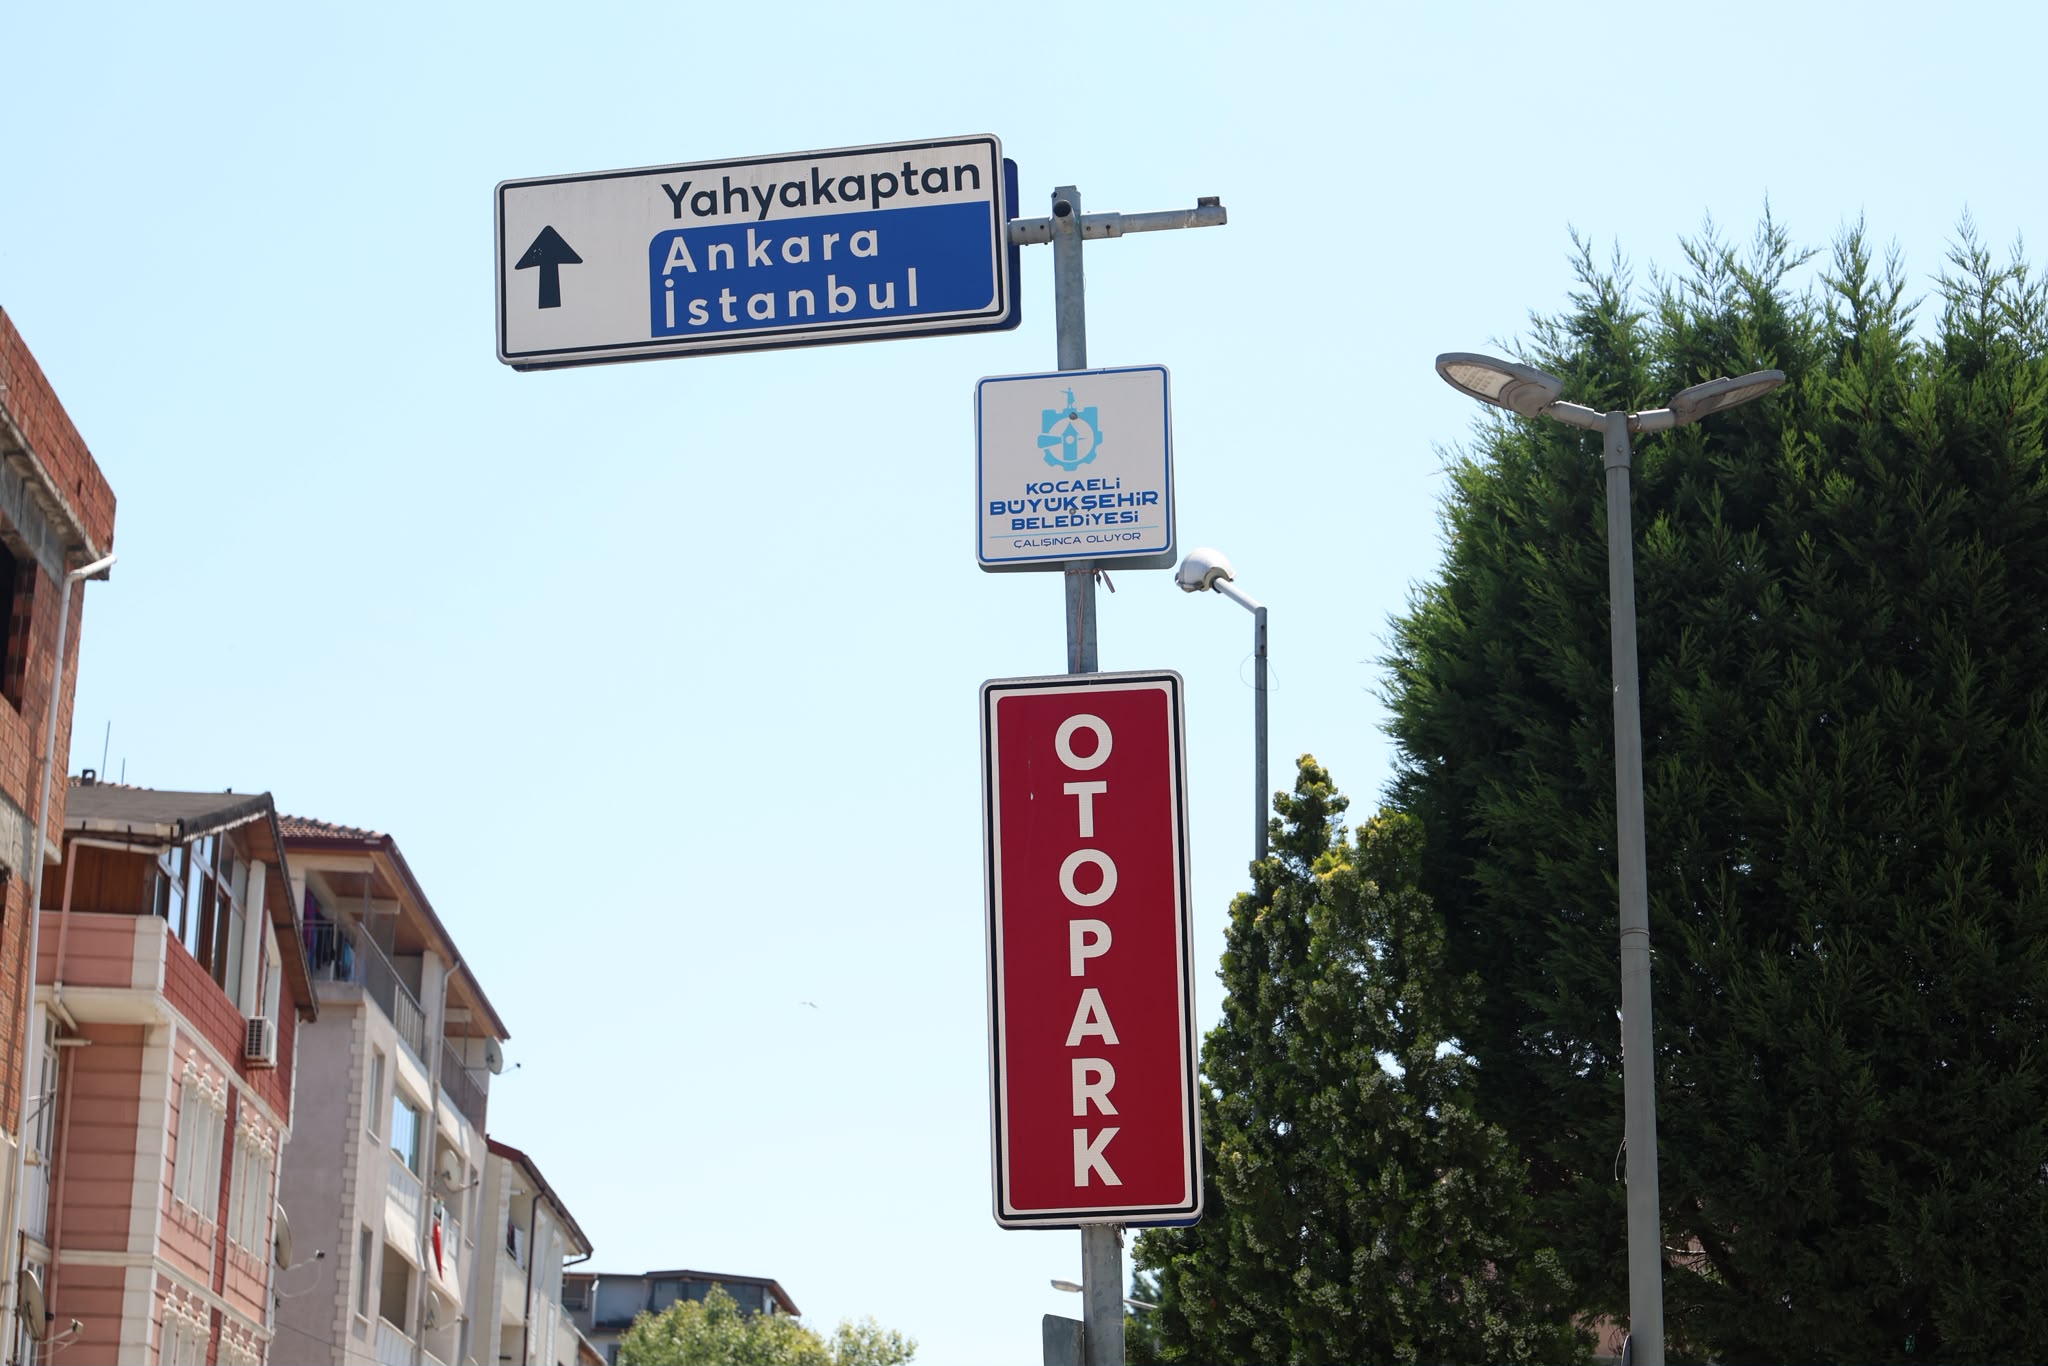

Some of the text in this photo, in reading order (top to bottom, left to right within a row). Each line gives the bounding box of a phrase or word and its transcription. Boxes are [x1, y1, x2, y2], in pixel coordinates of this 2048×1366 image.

[661, 161, 980, 221] Yahyakaptan
[662, 228, 879, 276] Ankara
[664, 267, 918, 328] İstanbul
[1013, 532, 1141, 548] ÇALIŞINCA OLUYOR
[1054, 713, 1123, 1188] OTOPARK
